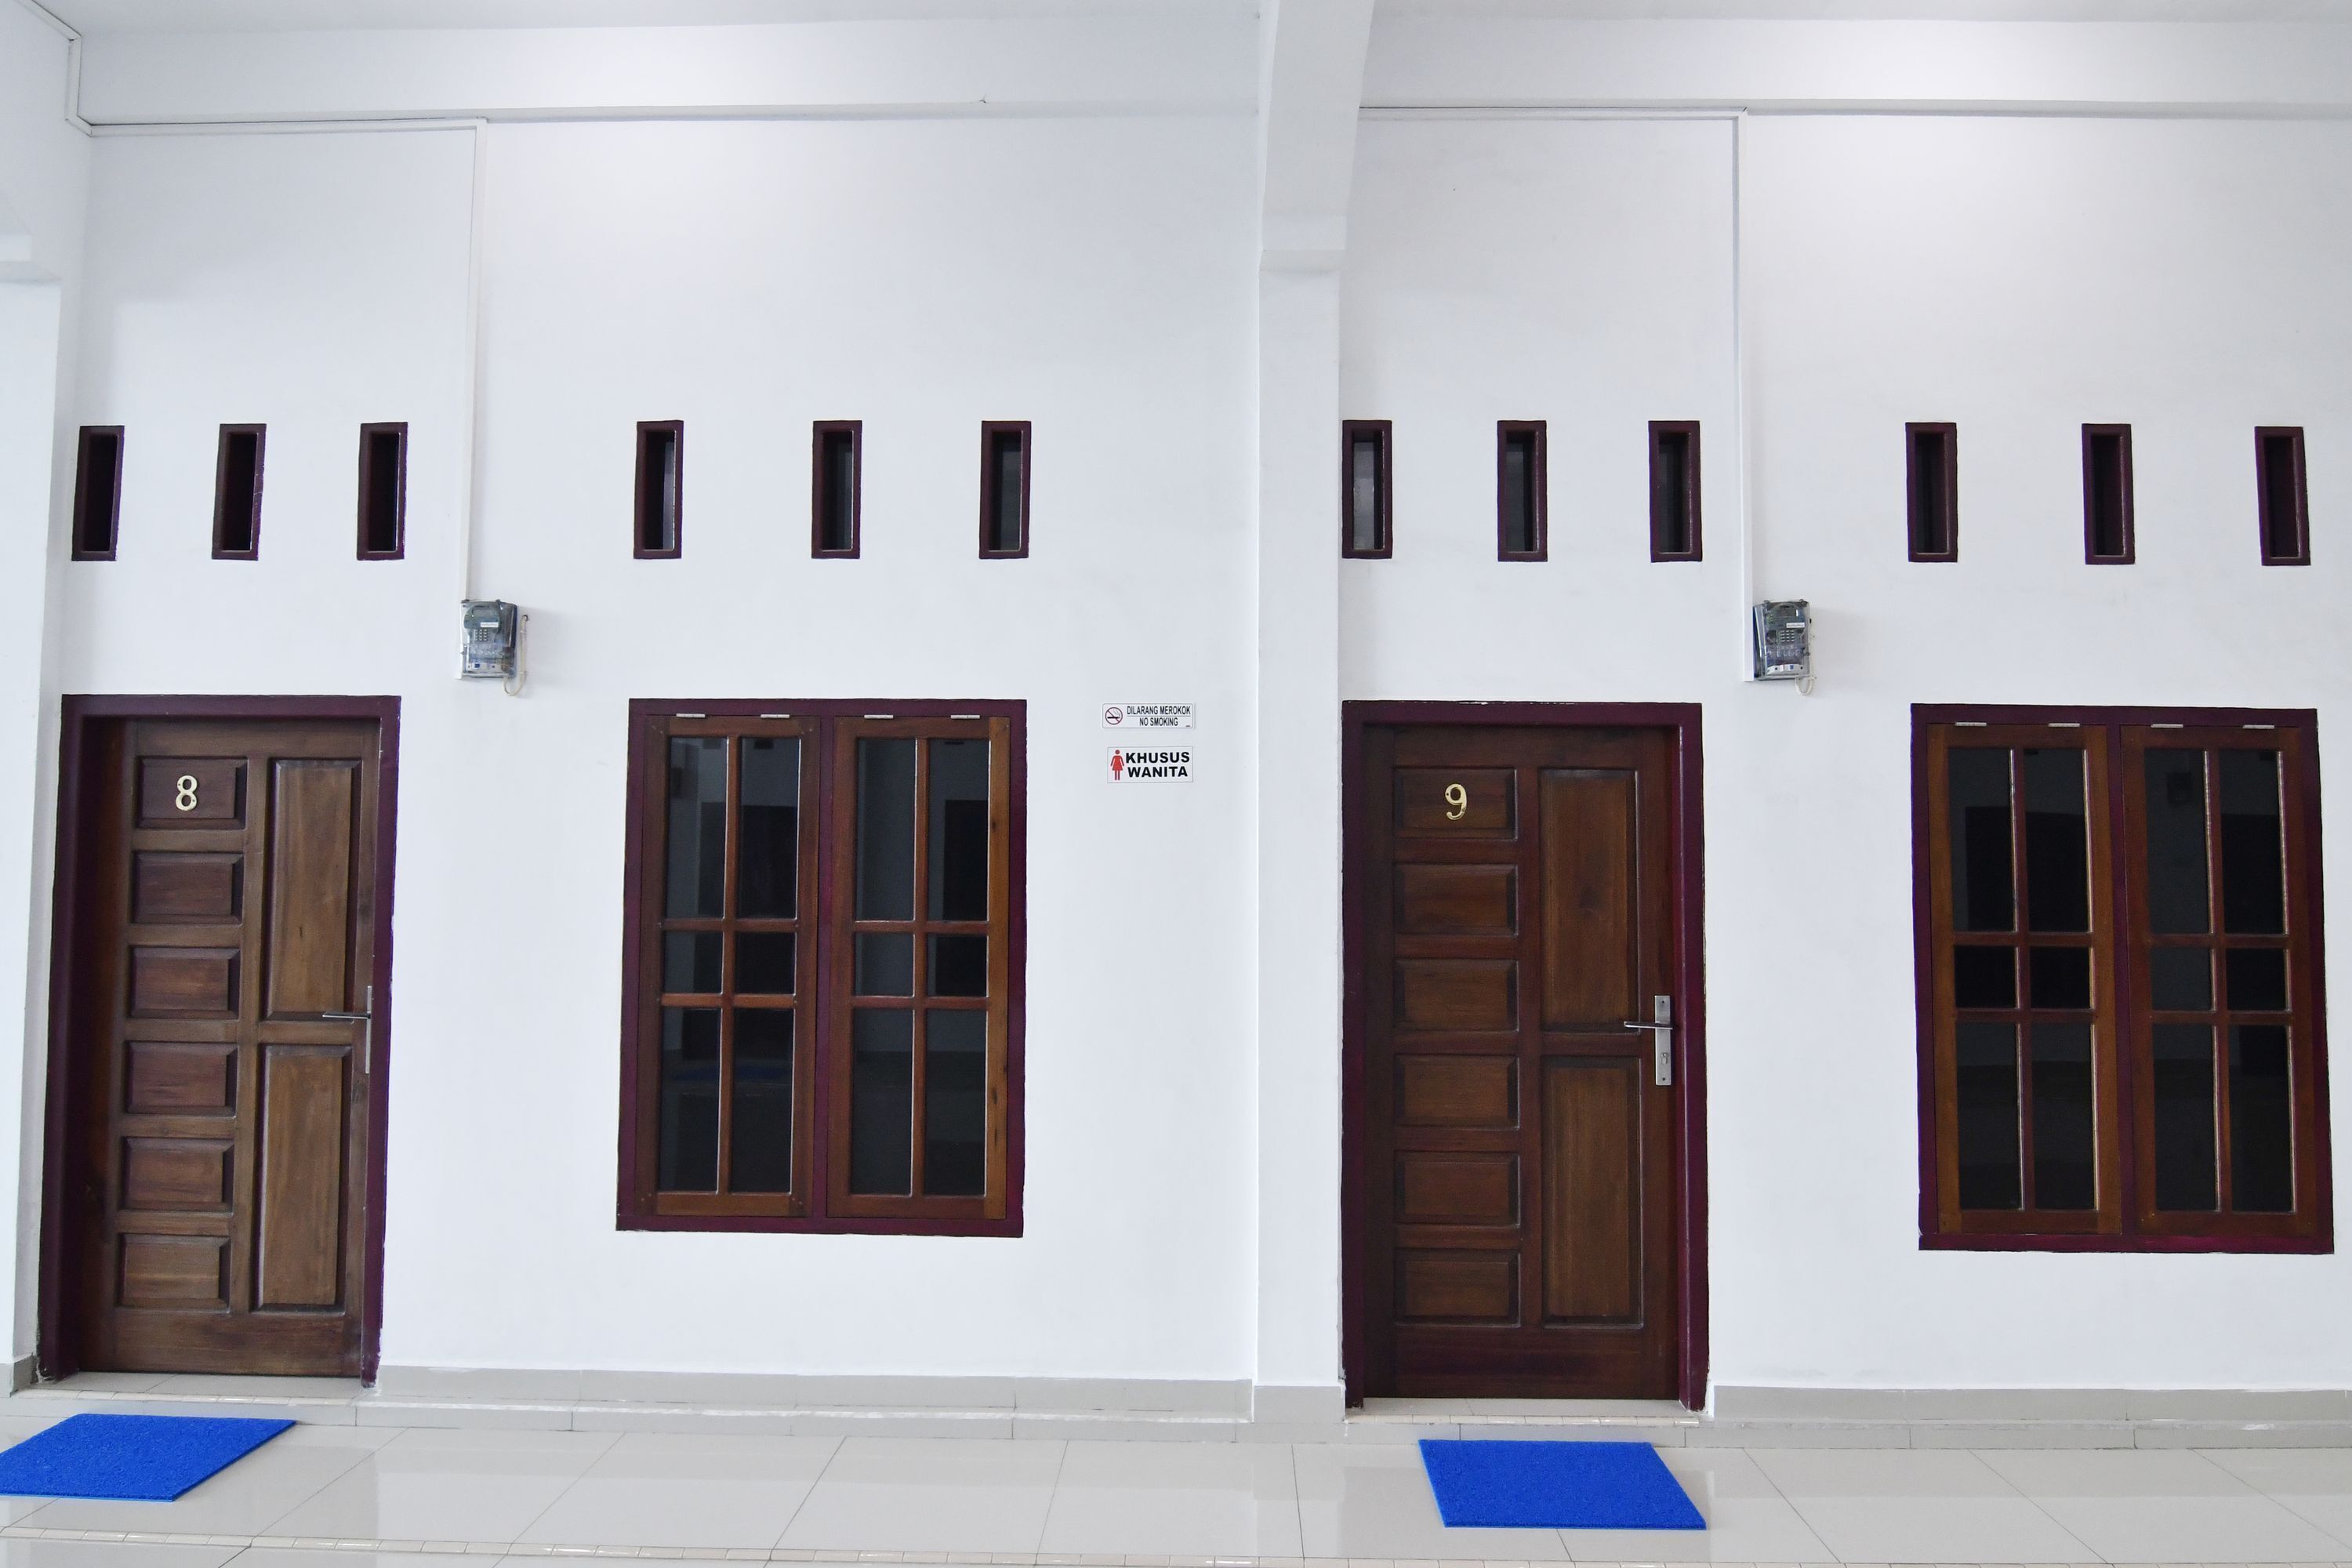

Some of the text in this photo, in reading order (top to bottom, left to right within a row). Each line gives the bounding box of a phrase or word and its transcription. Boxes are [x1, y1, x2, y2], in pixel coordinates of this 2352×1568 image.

[1127, 706, 1191, 715] DILARANG MEROKOK
[1139, 717, 1178, 726] NO SMOKING
[1125, 752, 1190, 764] KHUSUS
[1127, 766, 1189, 778] WANITA
[176, 775, 198, 811] 8
[1445, 783, 1468, 821] 9
